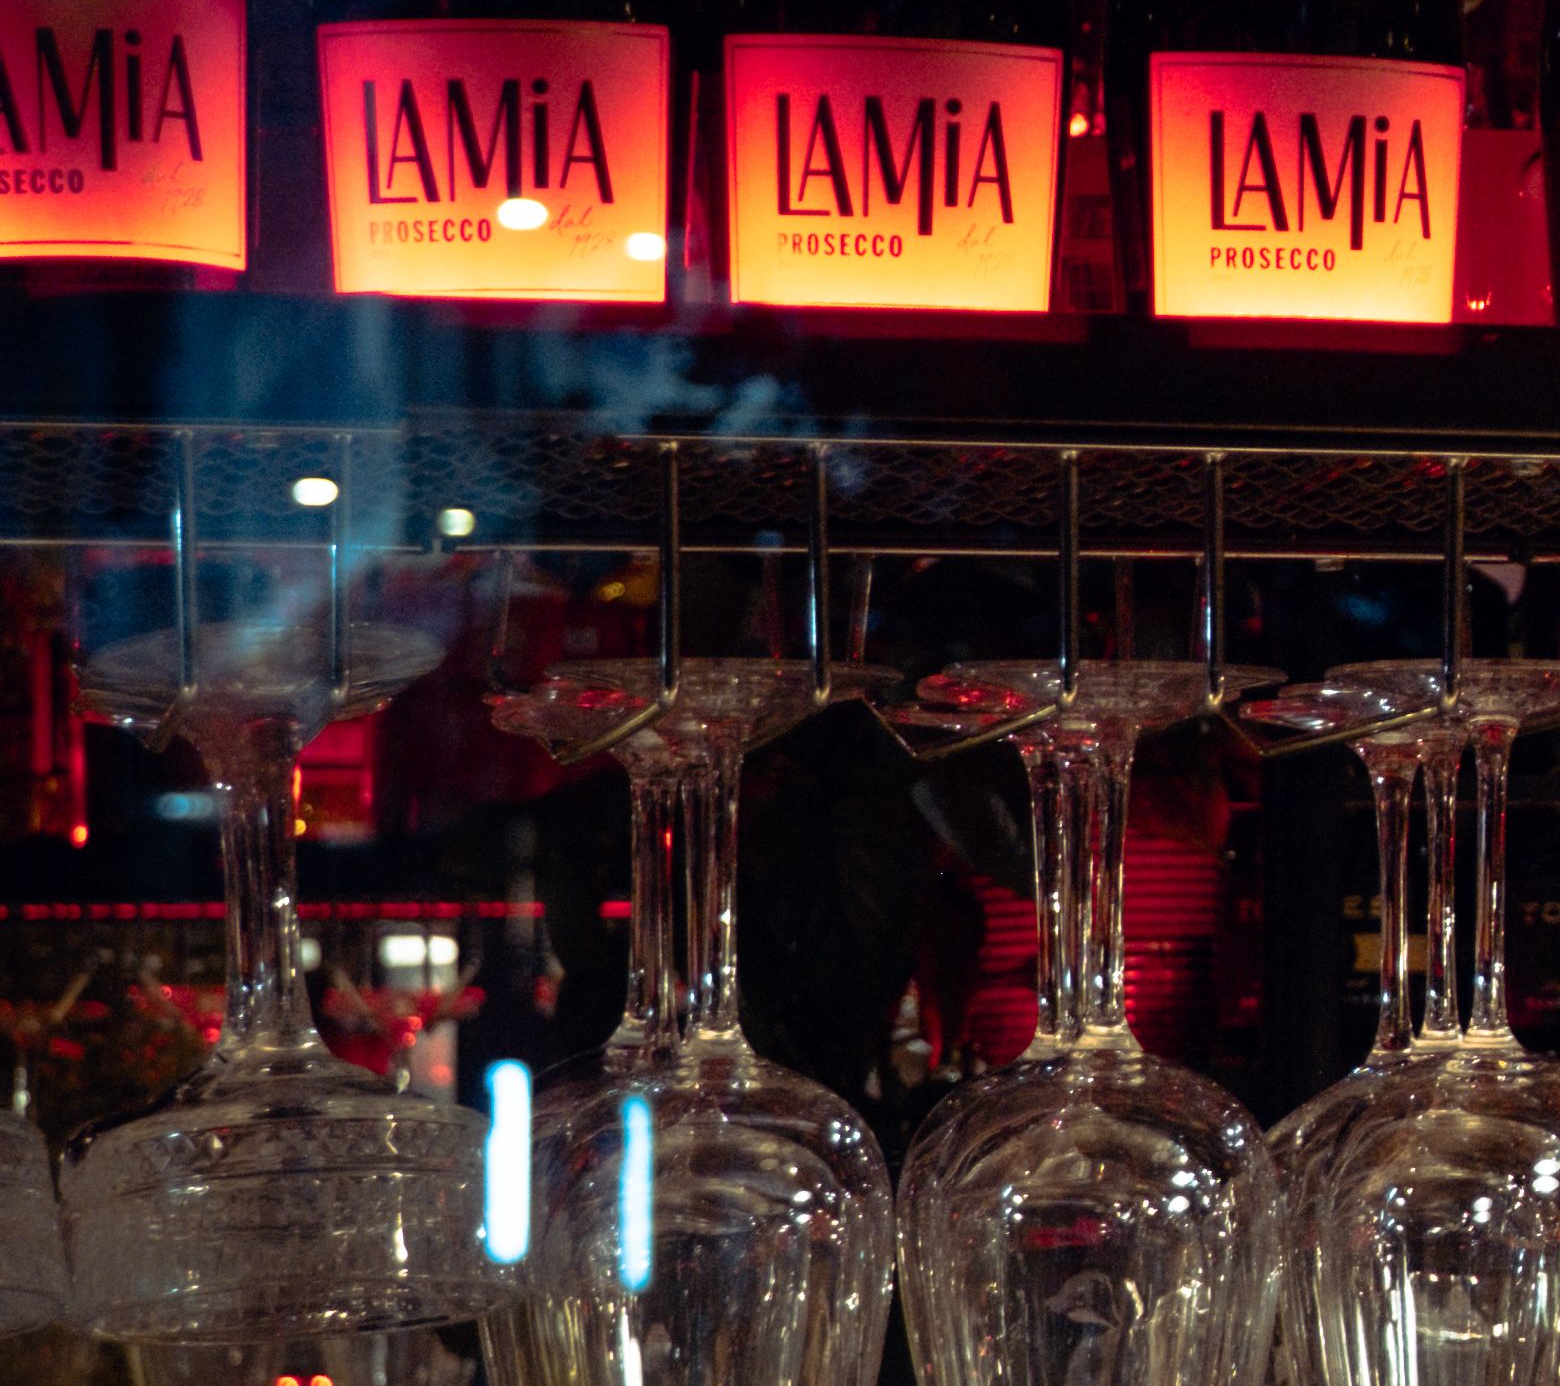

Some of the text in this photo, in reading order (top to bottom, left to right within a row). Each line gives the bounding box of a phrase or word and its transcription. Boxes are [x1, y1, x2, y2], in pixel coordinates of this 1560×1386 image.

[0, 27, 203, 172] AMiA
[0, 168, 84, 194] SECCO
[369, 217, 492, 244] PROSECCO
[777, 231, 904, 259] PROSECCO
[1210, 246, 1336, 273] PROSECCO
